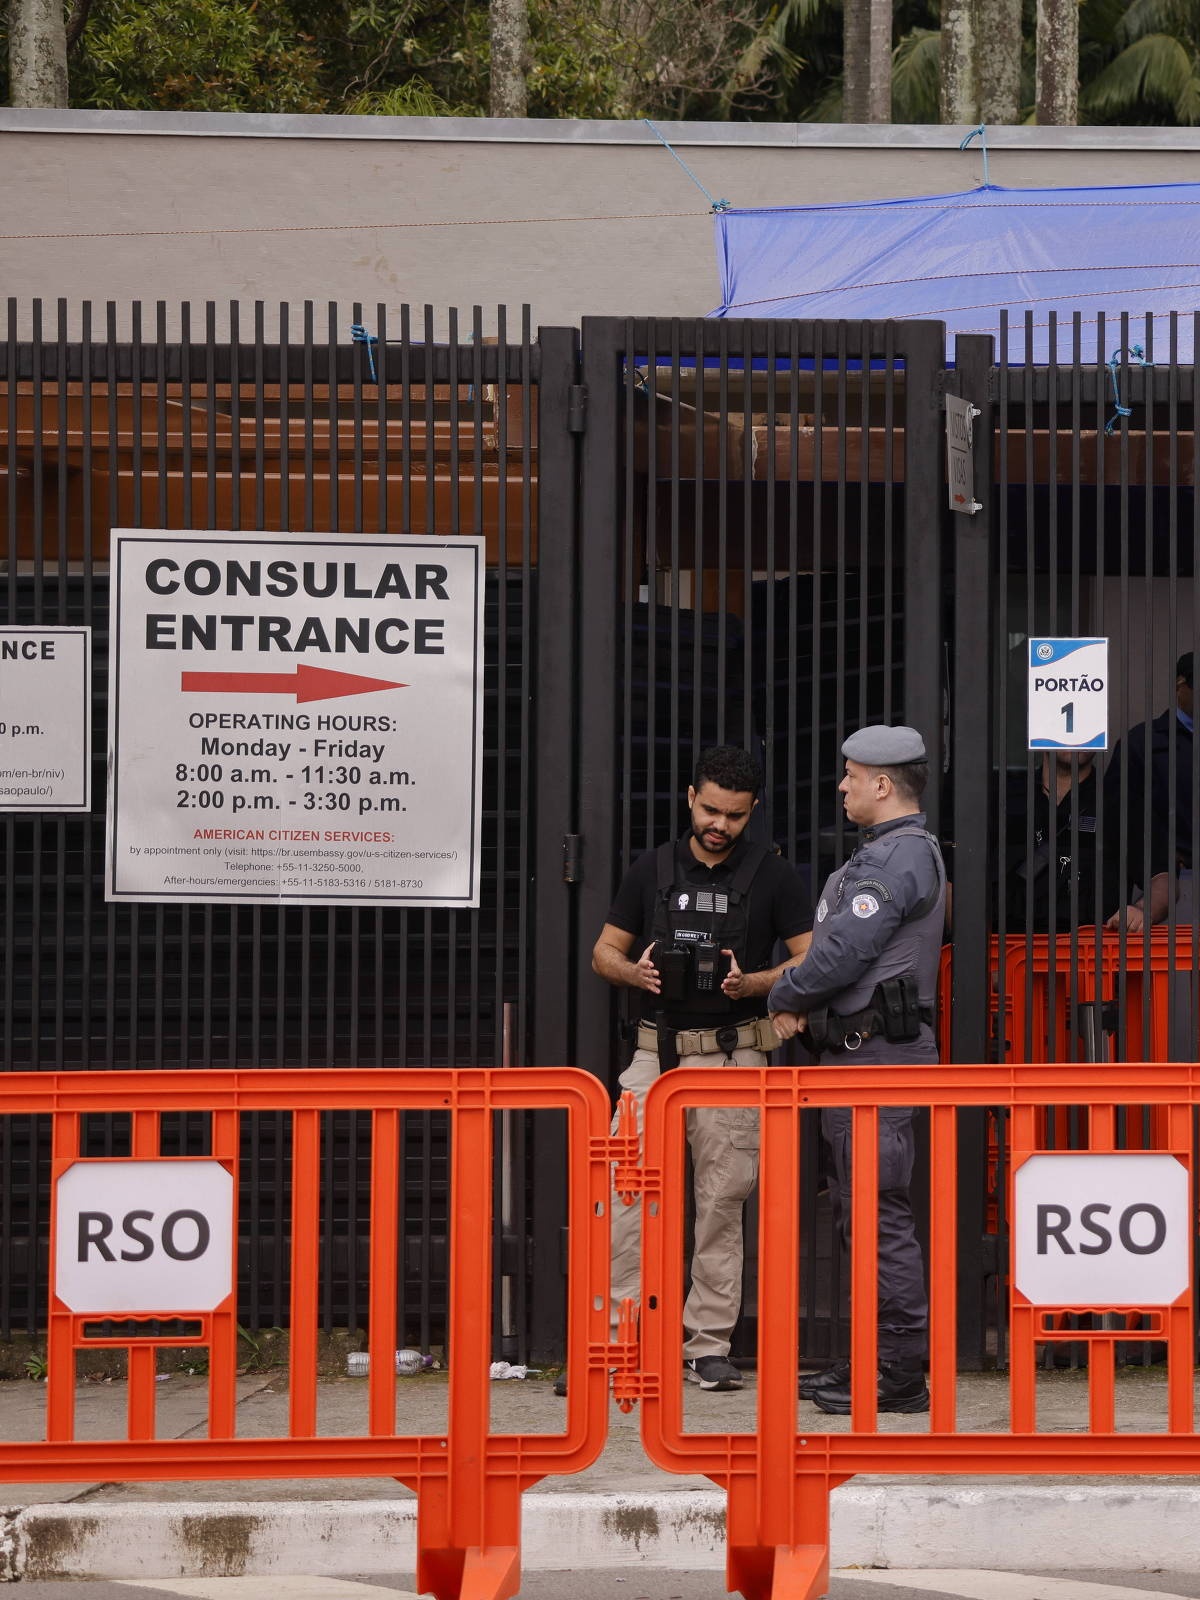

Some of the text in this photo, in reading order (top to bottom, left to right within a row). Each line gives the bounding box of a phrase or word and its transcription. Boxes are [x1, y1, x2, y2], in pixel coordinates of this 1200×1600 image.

[146, 559, 449, 599] CONSULAR
[146, 614, 444, 654] ENTRANCE
[1034, 674, 1104, 692] PORTÃO
[189, 713, 396, 731] OPERATING HOURS:
[1061, 702, 1074, 733] 1
[12, 725, 44, 737] p.m.
[202, 738, 291, 760] Monday
[315, 740, 384, 762] Friday
[176, 764, 222, 782] 8:00
[231, 769, 276, 782] a.m.
[302, 766, 360, 784] 11:30
[370, 772, 415, 784] a.m.
[177, 790, 223, 808] 2:00
[233, 796, 279, 813] p.m.
[304, 792, 350, 810] 3:30
[360, 798, 406, 815] p.m.
[194, 830, 393, 842] AMERICAN CITIZEN SERVICES:
[130, 846, 141, 855] by
[144, 847, 201, 857] appointment
[203, 847, 221, 857] only
[225, 847, 248, 857] (visit:
[224, 862, 274, 873] Telephone:
[164, 876, 280, 888] After-hours/emergencies:
[281, 878, 366, 888] +55-11-5183-5316
[374, 879, 423, 888] 5181-8730
[76, 1208, 211, 1263] RSO
[1036, 1202, 1167, 1257] RSO
